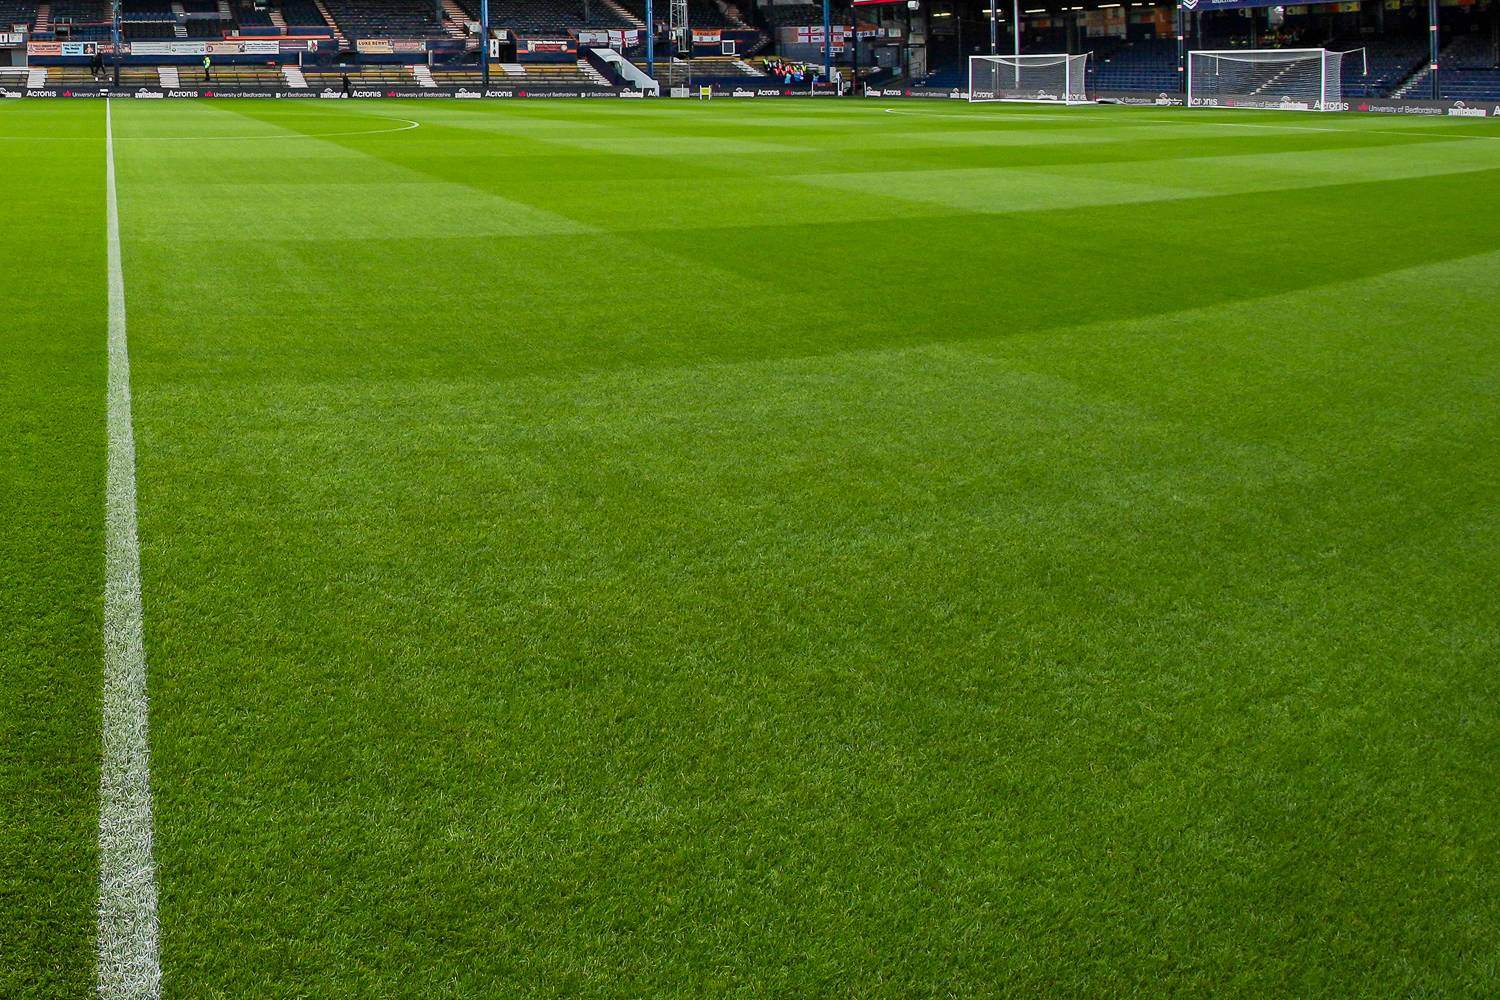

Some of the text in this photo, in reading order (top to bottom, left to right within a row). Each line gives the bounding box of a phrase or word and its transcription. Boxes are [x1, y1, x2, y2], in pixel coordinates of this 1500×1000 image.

[26, 89, 57, 98] Acronis
[167, 89, 199, 98] Acronis
[352, 90, 382, 98] Acronis
[485, 89, 513, 98] Acronis
[972, 90, 994, 98] Acronis
[1368, 105, 1397, 113] University
[1404, 106, 1442, 114] Bedfordshire
